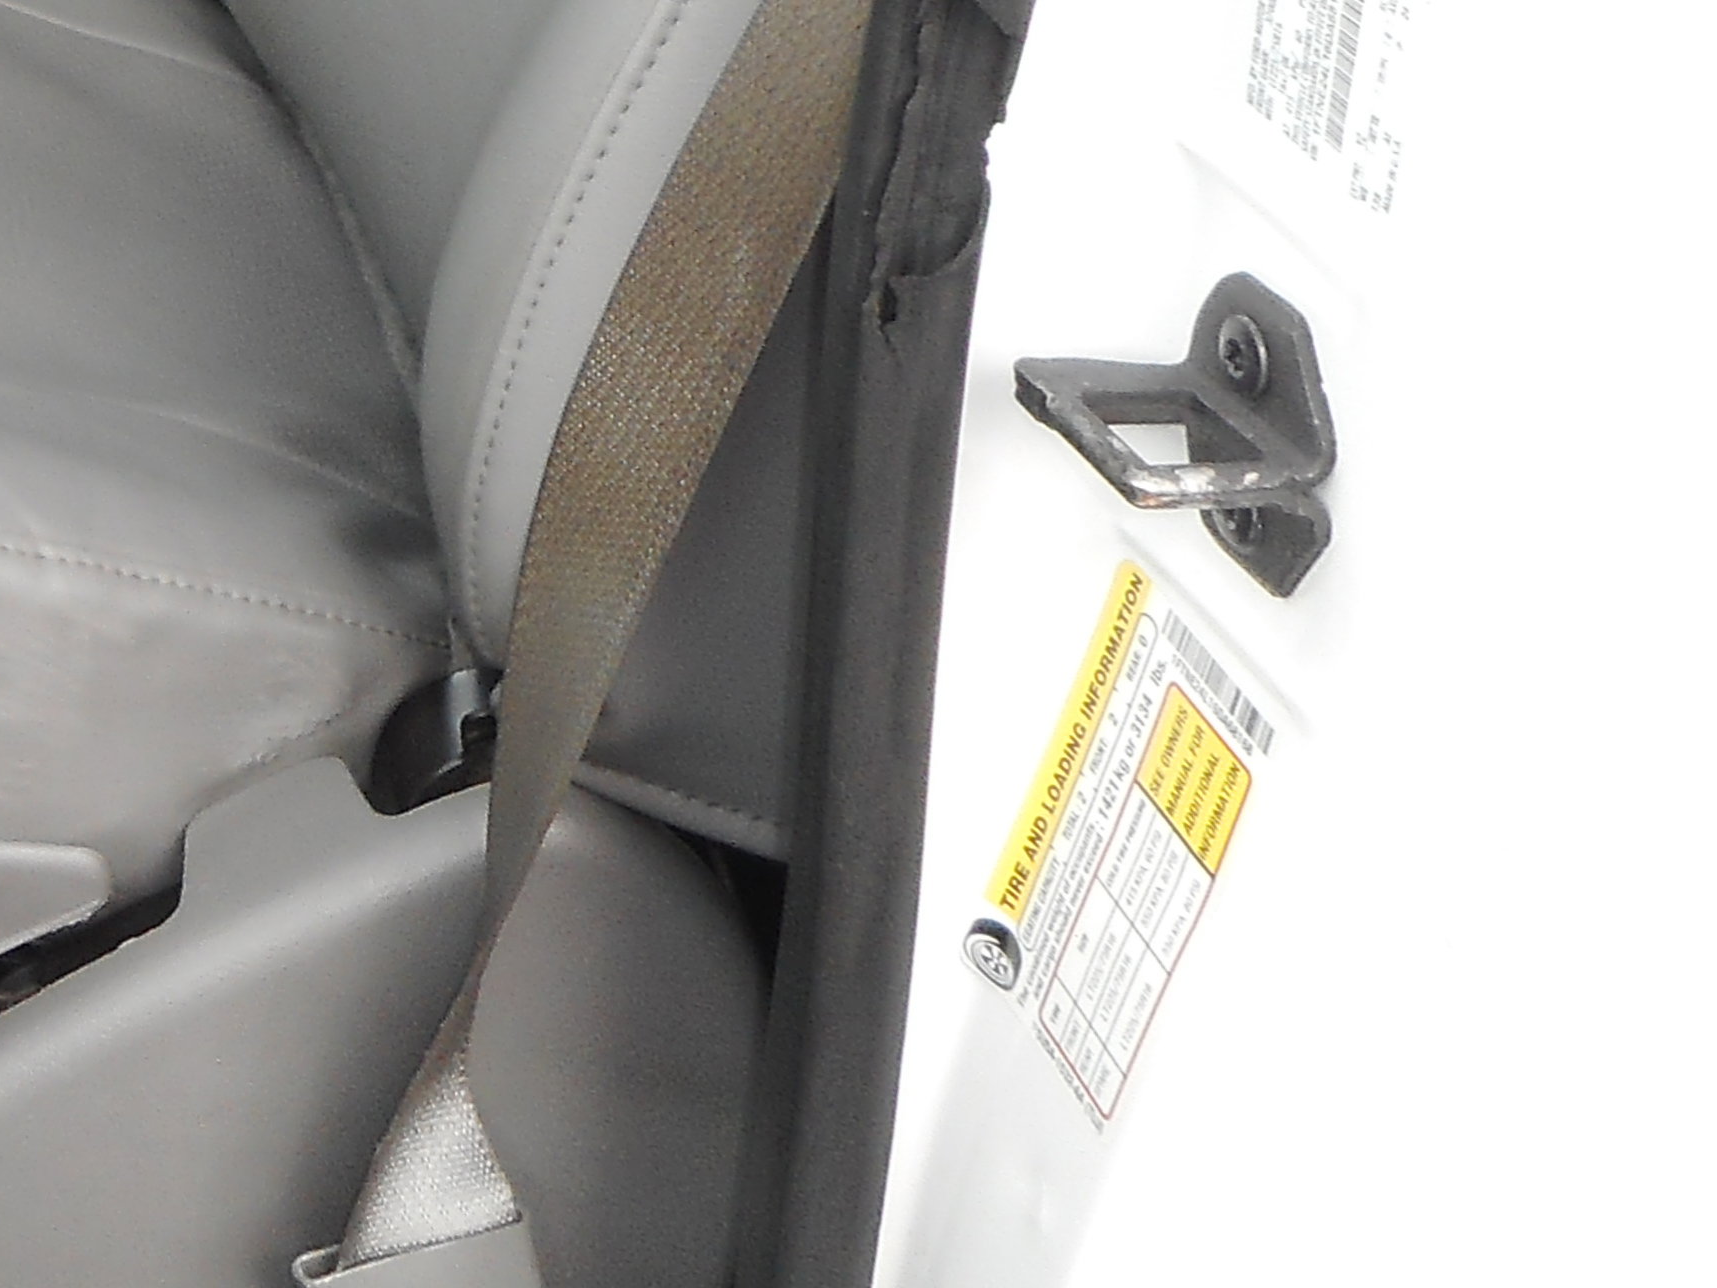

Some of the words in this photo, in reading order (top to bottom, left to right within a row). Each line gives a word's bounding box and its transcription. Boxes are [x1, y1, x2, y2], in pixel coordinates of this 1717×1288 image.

[999, 861, 1030, 910] TIRE
[1023, 816, 1048, 862] AND
[1041, 722, 1086, 814] LOADING
[1080, 573, 1142, 720] INFORMATION
[1098, 779, 1119, 819] 1421
[1112, 758, 1130, 782] kg
[1124, 738, 1136, 759] or
[1130, 693, 1153, 739] 3134
[1149, 769, 1165, 797] SEE
[1161, 708, 1188, 768] OWNERS
[1165, 759, 1193, 817] MANUAL
[1188, 724, 1205, 757] FOR
[1183, 754, 1220, 836] ADDITIONAL
[1198, 763, 1240, 860] INFORMATION
